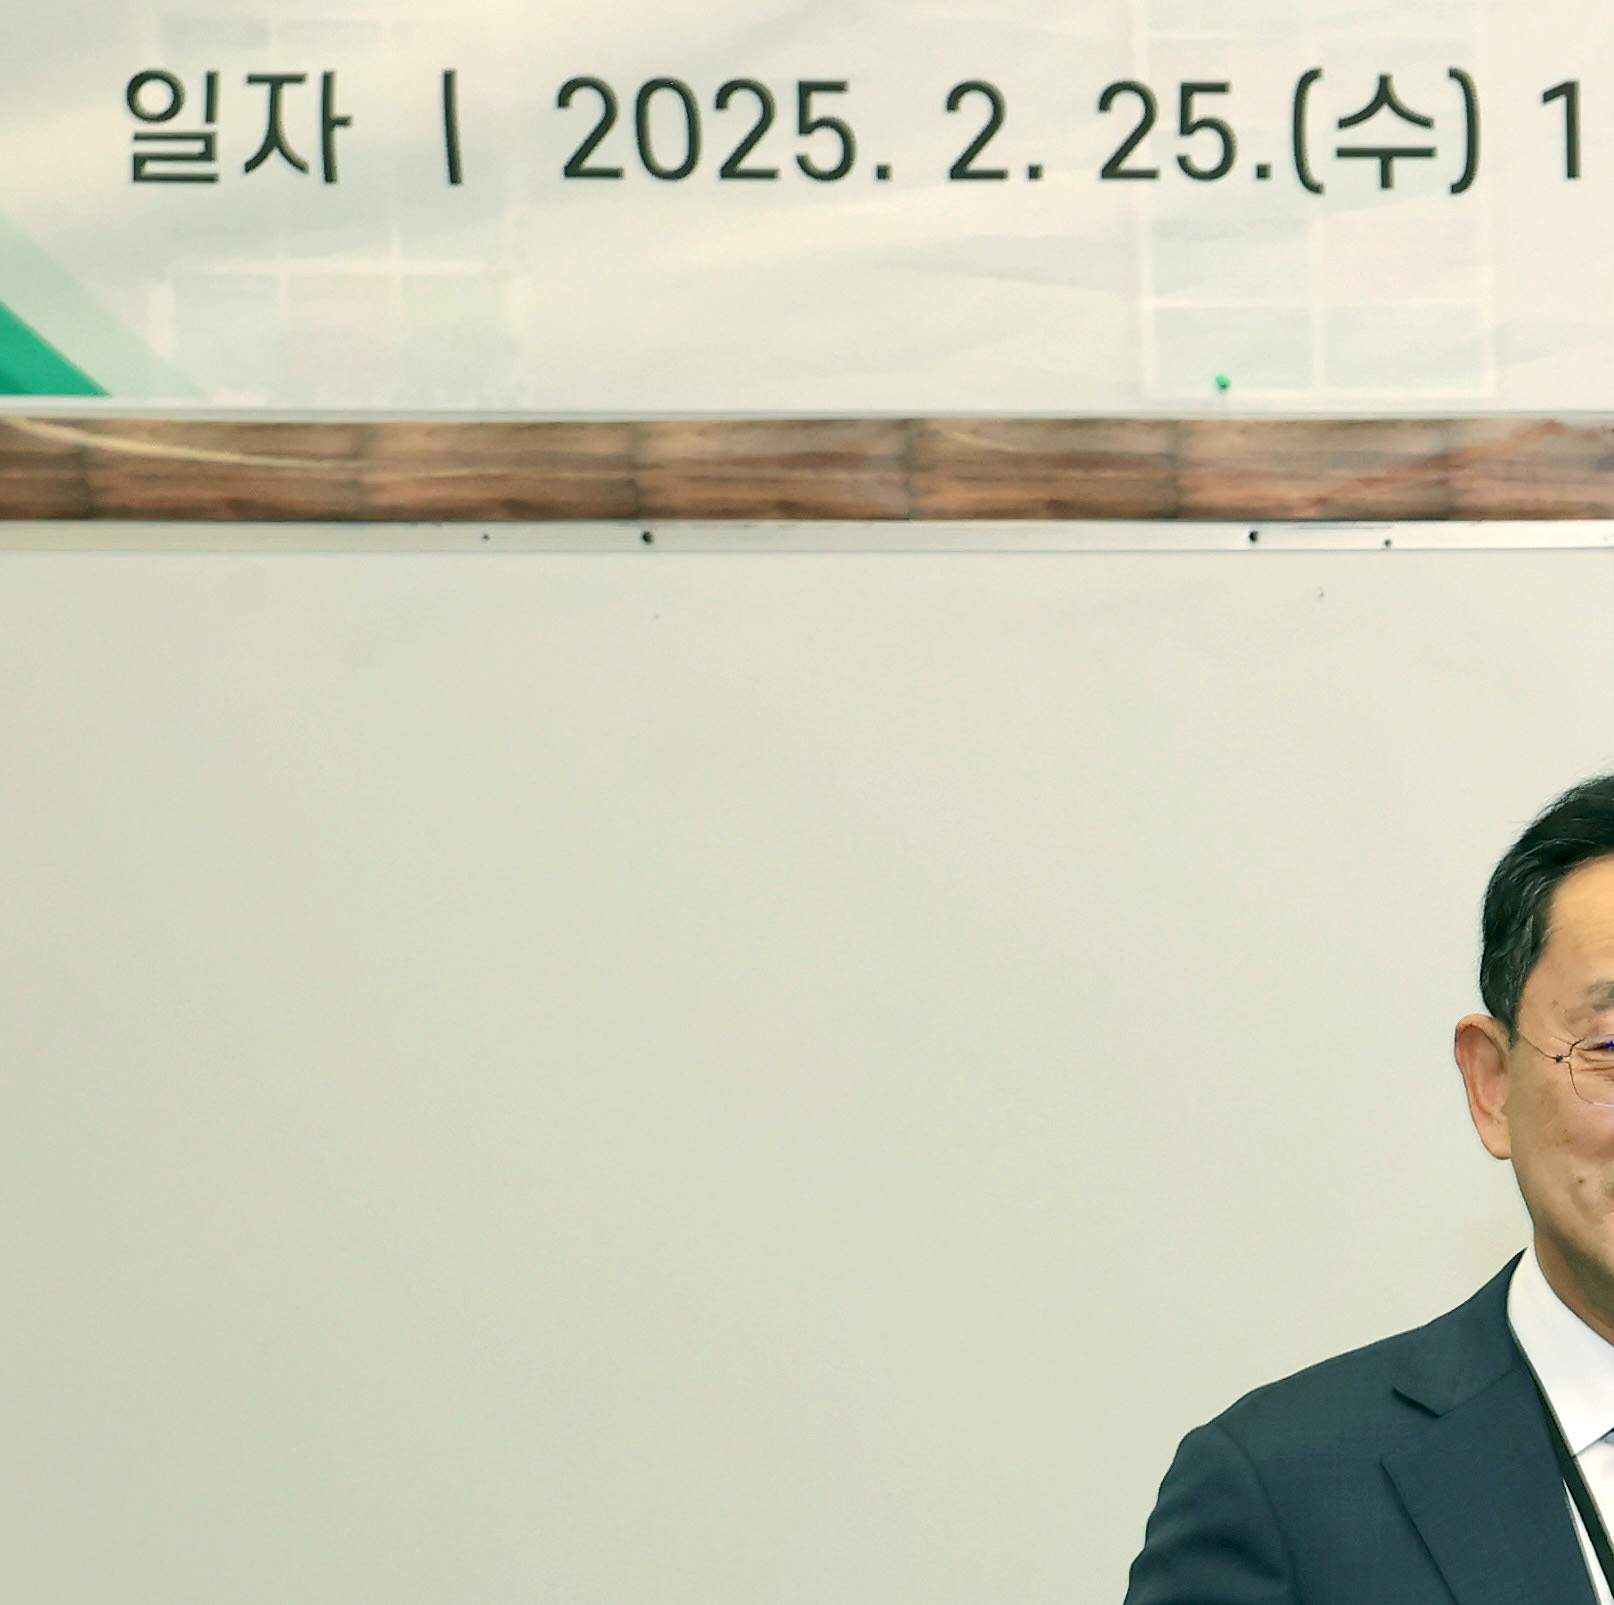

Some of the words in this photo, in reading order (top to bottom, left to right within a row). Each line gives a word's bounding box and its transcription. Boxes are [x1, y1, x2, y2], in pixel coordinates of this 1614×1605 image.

[126, 69, 352, 185] 일자
[556, 76, 892, 181] 2025.
[945, 79, 1043, 181] 2.
[1097, 68, 1480, 194] 25.(수)
